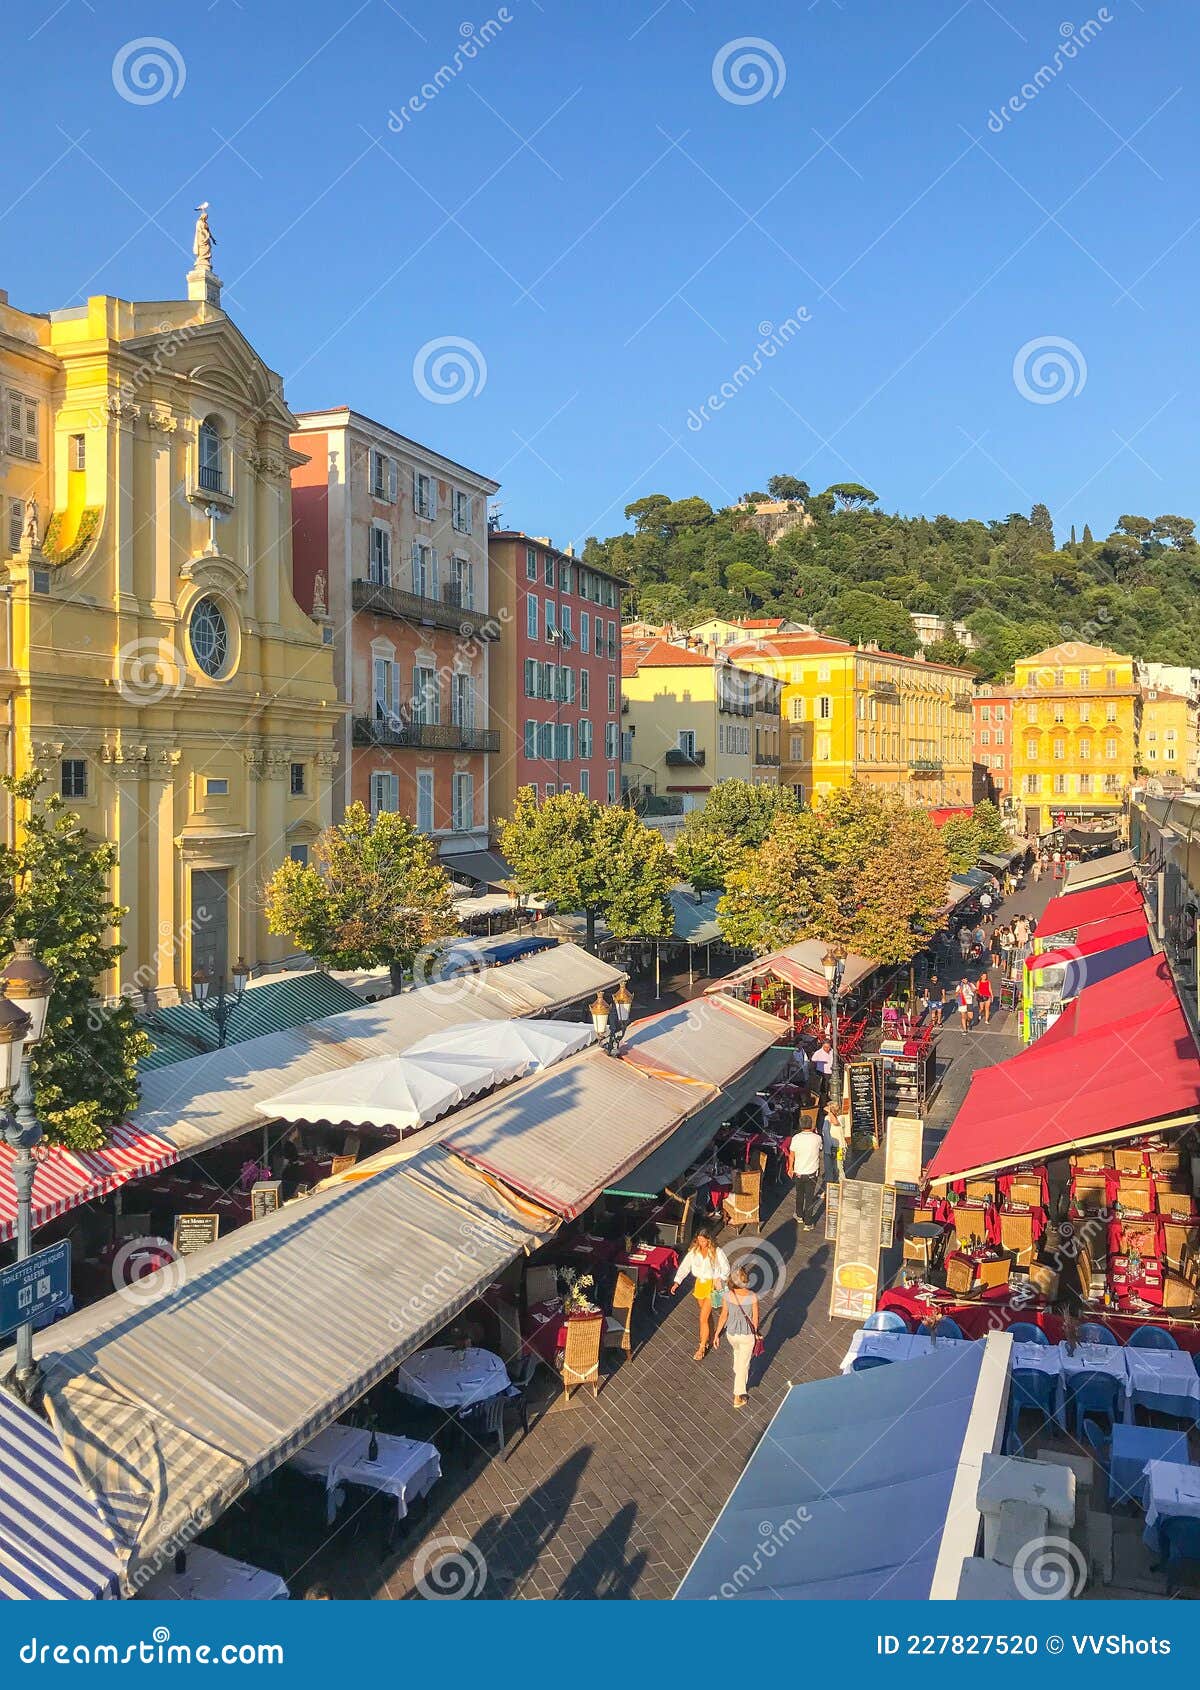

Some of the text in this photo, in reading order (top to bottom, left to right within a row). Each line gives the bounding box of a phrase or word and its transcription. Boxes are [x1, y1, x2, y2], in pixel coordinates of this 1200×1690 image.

[2, 1250, 65, 1288] TOILETTES PUBLIQUES
[23, 1268, 45, 1285] SALEYA
